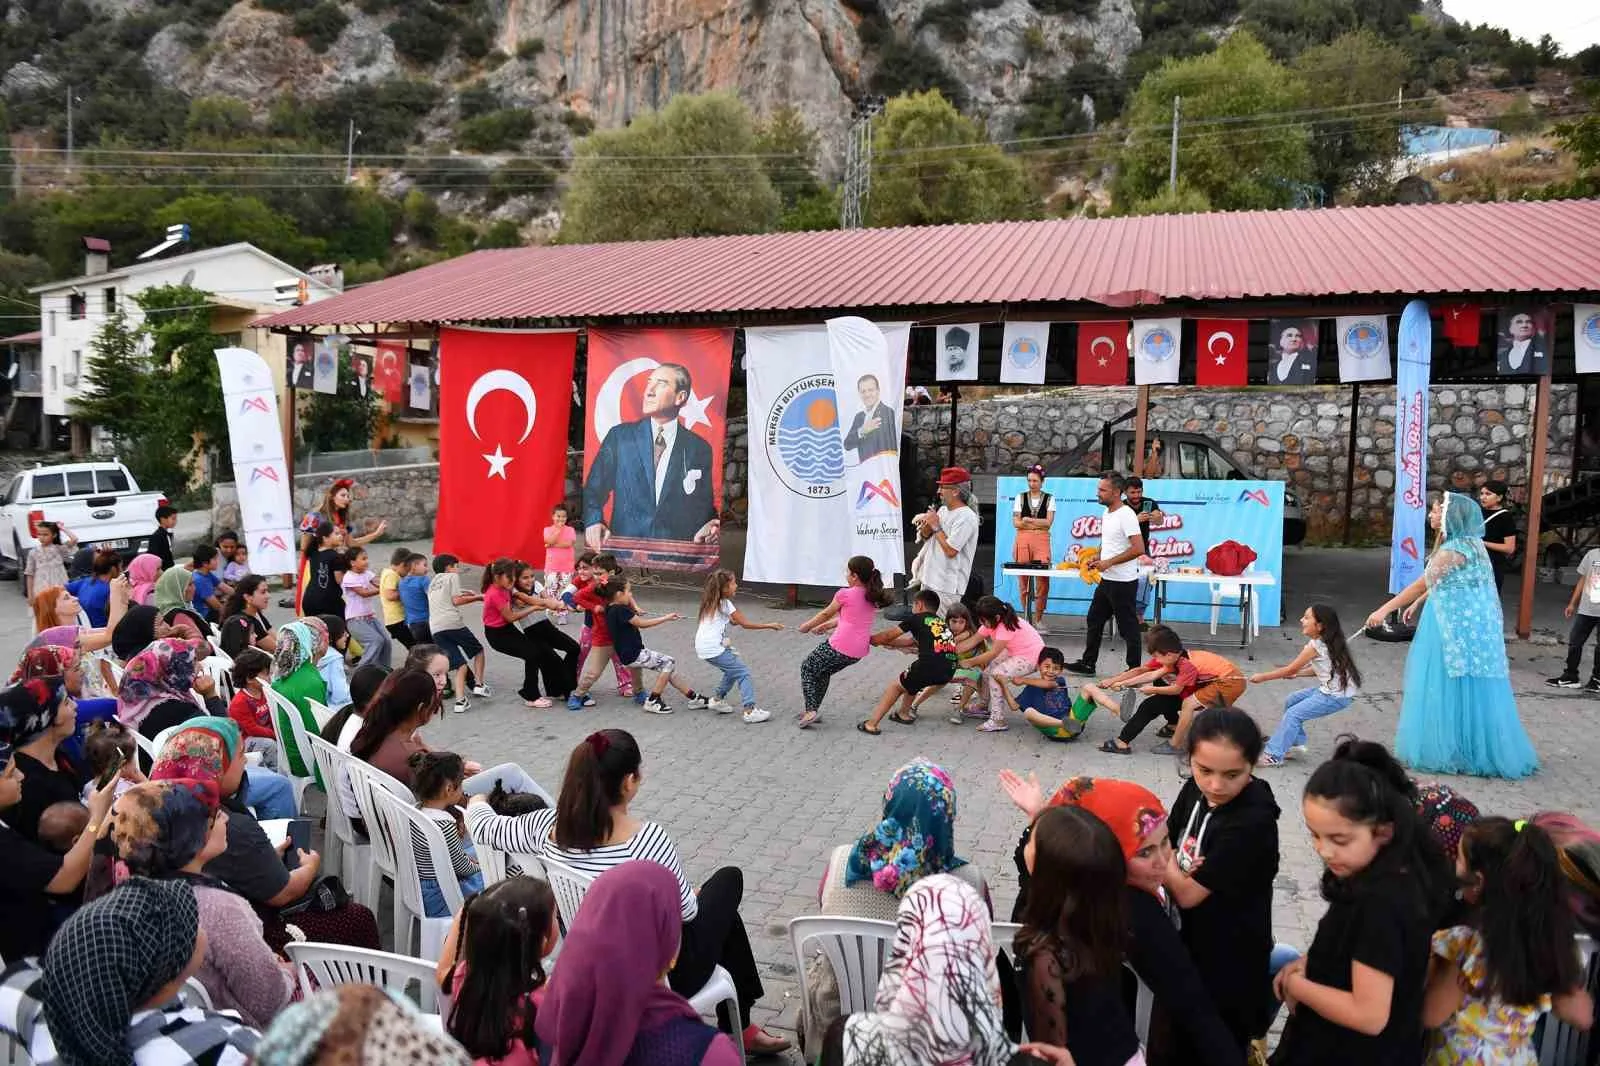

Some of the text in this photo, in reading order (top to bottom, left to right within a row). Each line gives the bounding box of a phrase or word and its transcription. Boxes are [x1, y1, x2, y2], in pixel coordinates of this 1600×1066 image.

[769, 378, 835, 446] MERSİN BÜYÜKŞEH
[807, 486, 831, 495] 1873
[1149, 536, 1194, 558] izim
